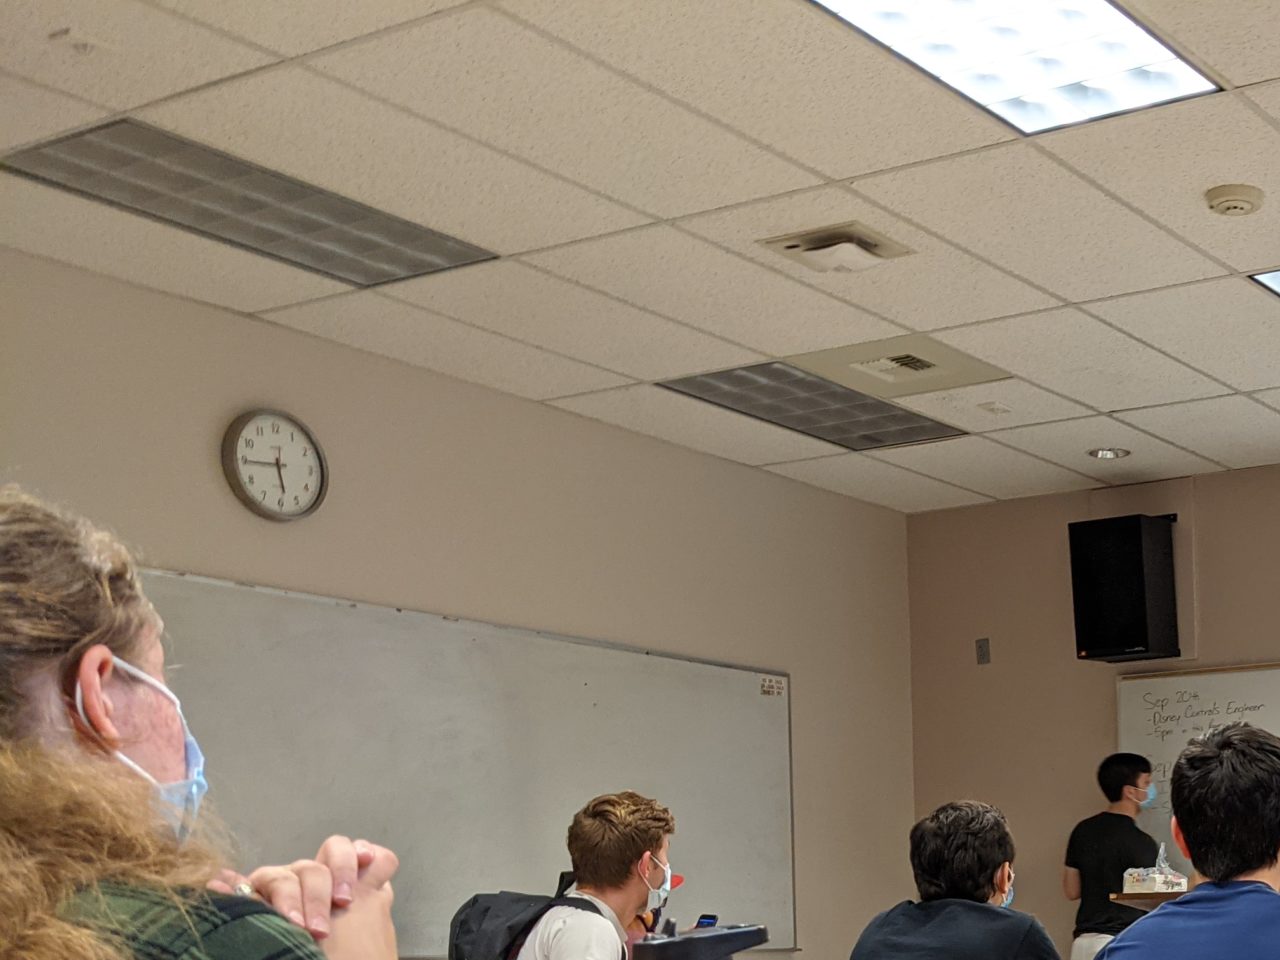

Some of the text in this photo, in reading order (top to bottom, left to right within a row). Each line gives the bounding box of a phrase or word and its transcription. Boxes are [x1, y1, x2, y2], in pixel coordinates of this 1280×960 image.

[256, 426, 264, 436] 11
[271, 423, 280, 434] 12
[244, 438, 254, 449] 10
[1142, 691, 1169, 712] Sep
[1226, 700, 1266, 720] Engineer
